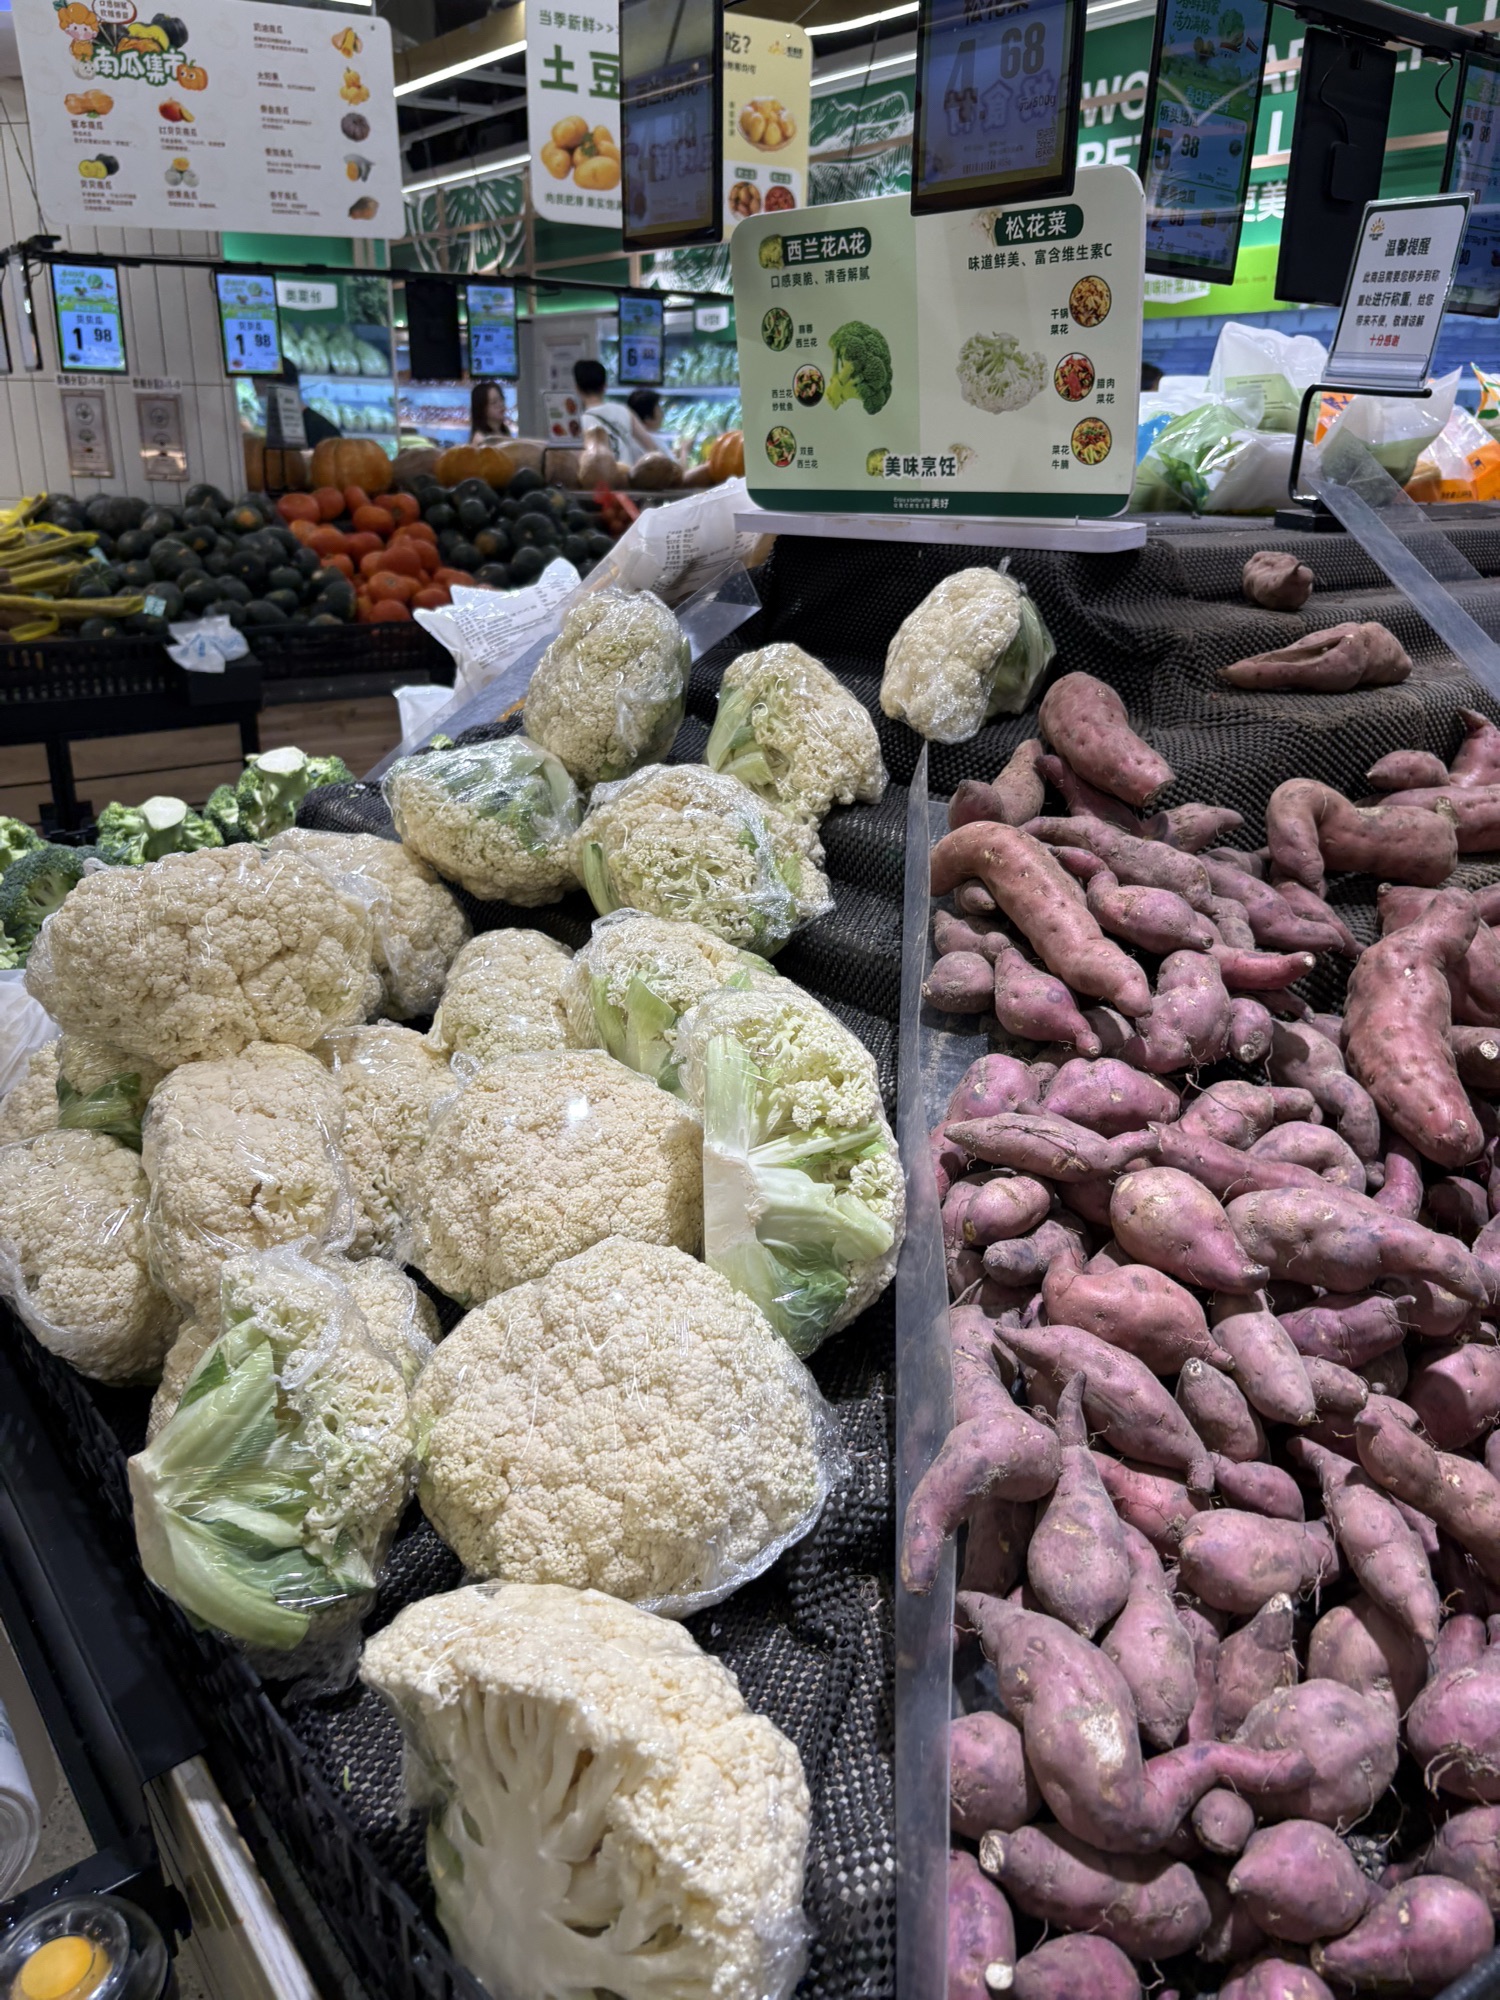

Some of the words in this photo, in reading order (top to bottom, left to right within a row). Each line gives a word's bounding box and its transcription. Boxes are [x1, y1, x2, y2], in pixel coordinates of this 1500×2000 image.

[93, 47, 184, 83] 南瓜集市
[540, 45, 620, 101] 土豆
[1005, 210, 1067, 241] 松花菜
[786, 231, 867, 263] 西兰花A花
[1384, 237, 1432, 257] 温馨提醒
[967, 243, 1113, 272] 味道鲜美、富含维生素C
[770, 265, 871, 289] 口感爽脆、清香解腻
[1362, 269, 1440, 284] 此商品需要您移步到称
[1050, 308, 1069, 320] 干锅
[1050, 323, 1069, 335] 菜花
[795, 338, 818, 349] 西兰花
[1369, 333, 1401, 347] 十分感谢
[1096, 378, 1115, 390] 腊肉
[771, 389, 794, 400] 西兰花
[1096, 393, 1115, 405] 菜花
[1051, 444, 1070, 456] 菜花
[797, 459, 819, 470] 西兰花
[885, 455, 957, 477] 美味烹饪
[1051, 459, 1070, 470] 牛腩
[931, 498, 950, 509] 美好
